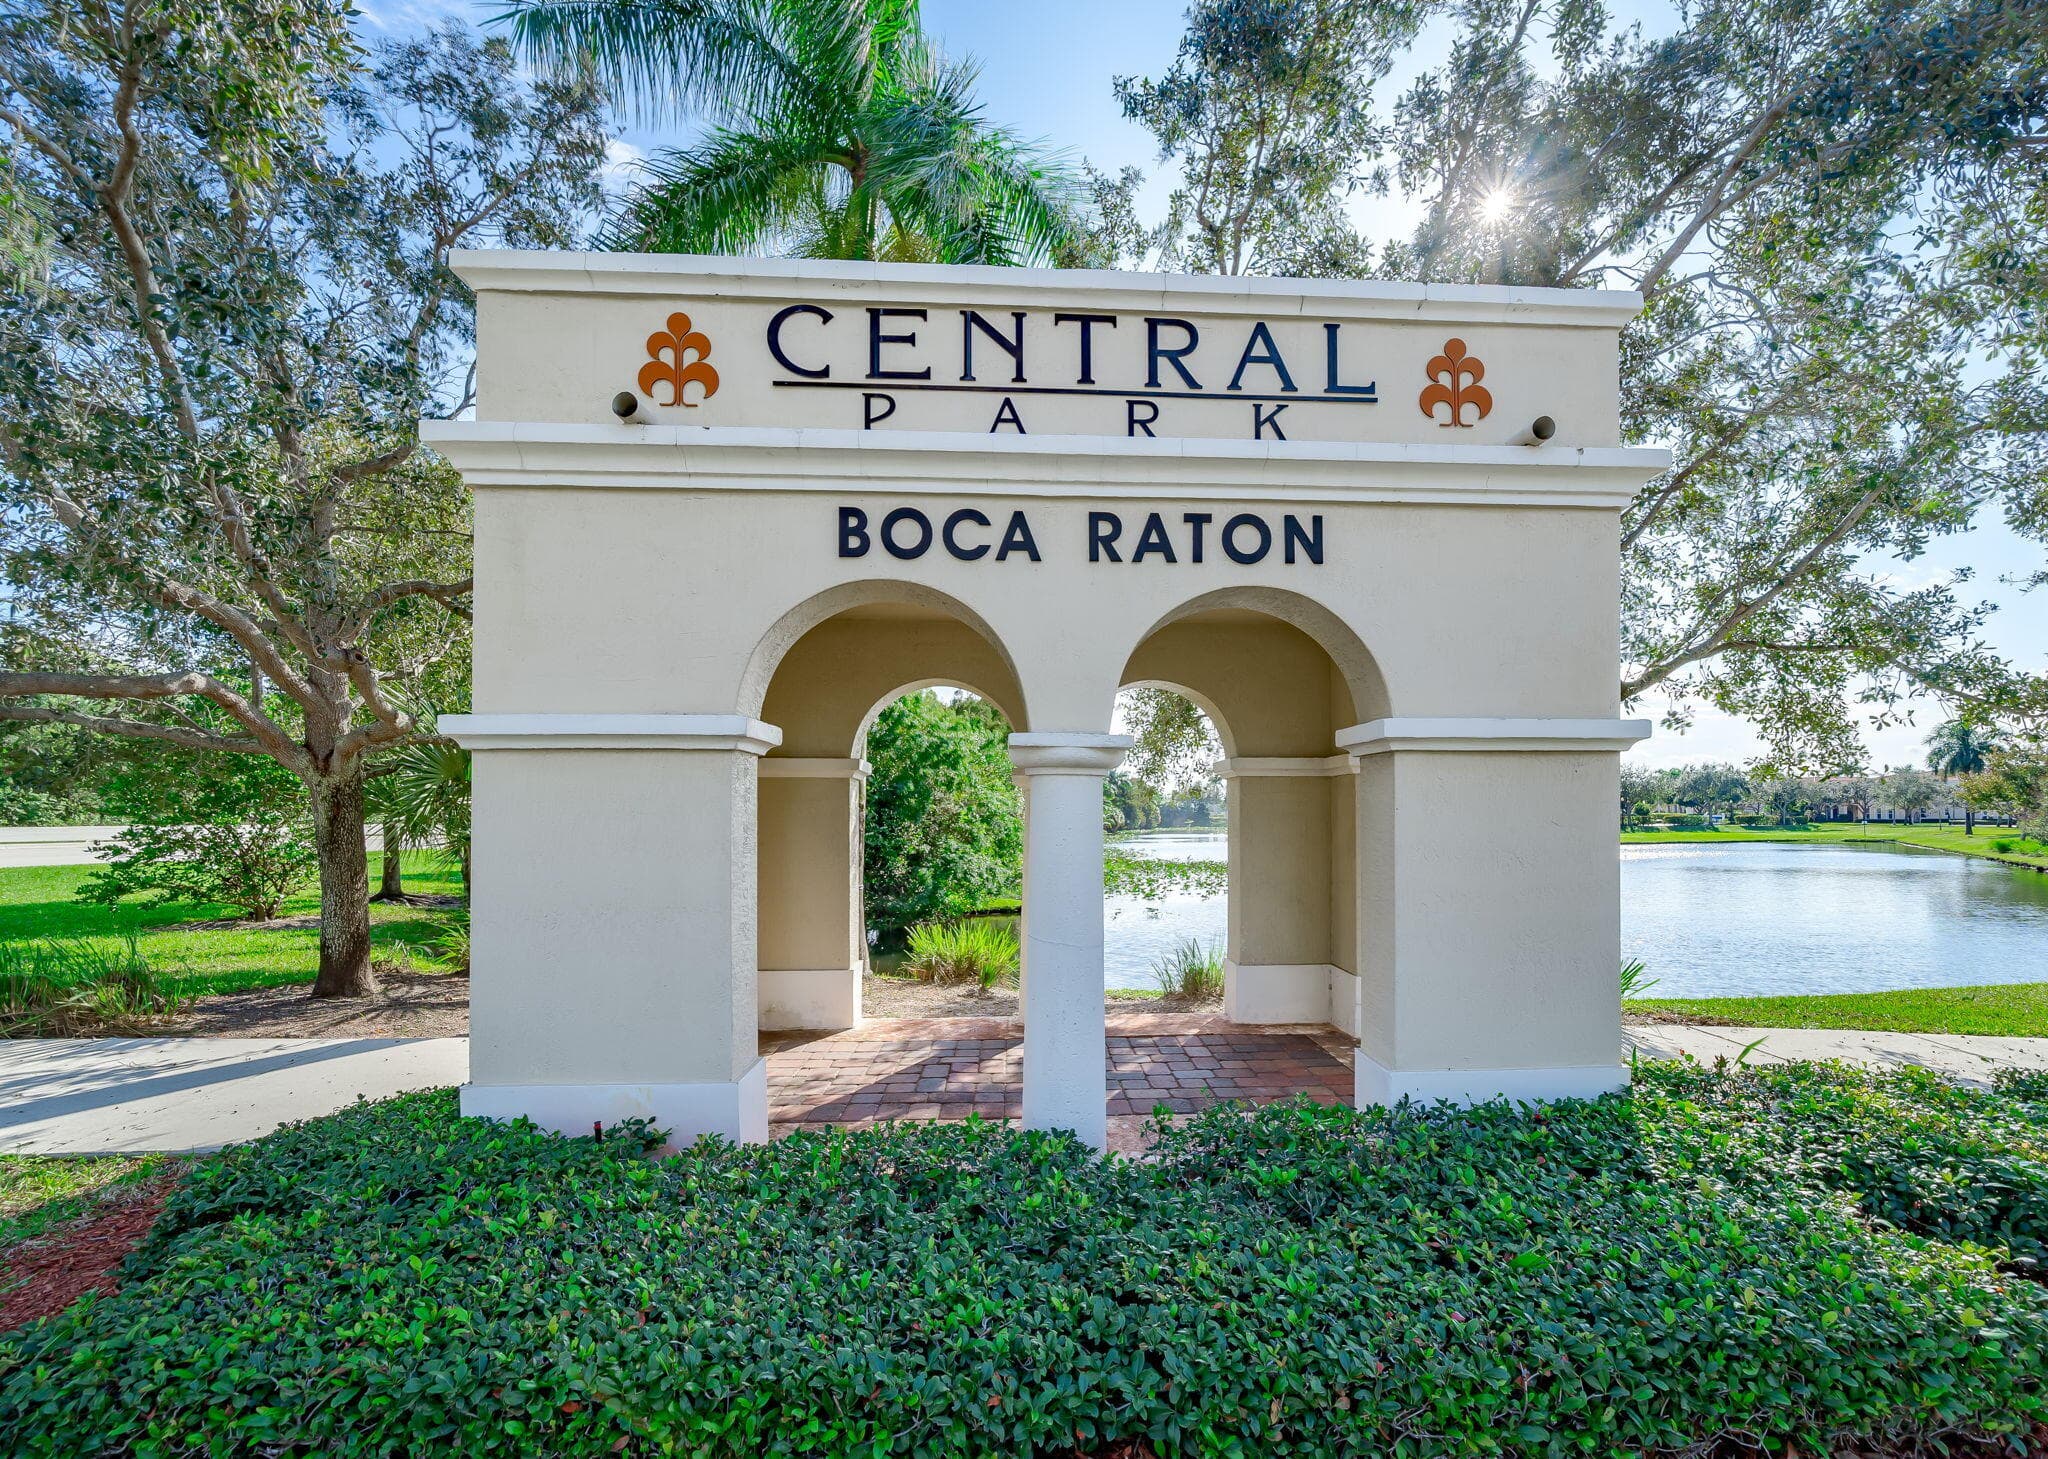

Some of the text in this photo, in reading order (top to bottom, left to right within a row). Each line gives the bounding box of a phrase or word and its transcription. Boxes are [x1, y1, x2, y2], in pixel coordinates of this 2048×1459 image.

[767, 304, 1376, 394] CENTRAL
[862, 393, 1289, 440] PARK
[838, 507, 1324, 565] BOCA RATON
